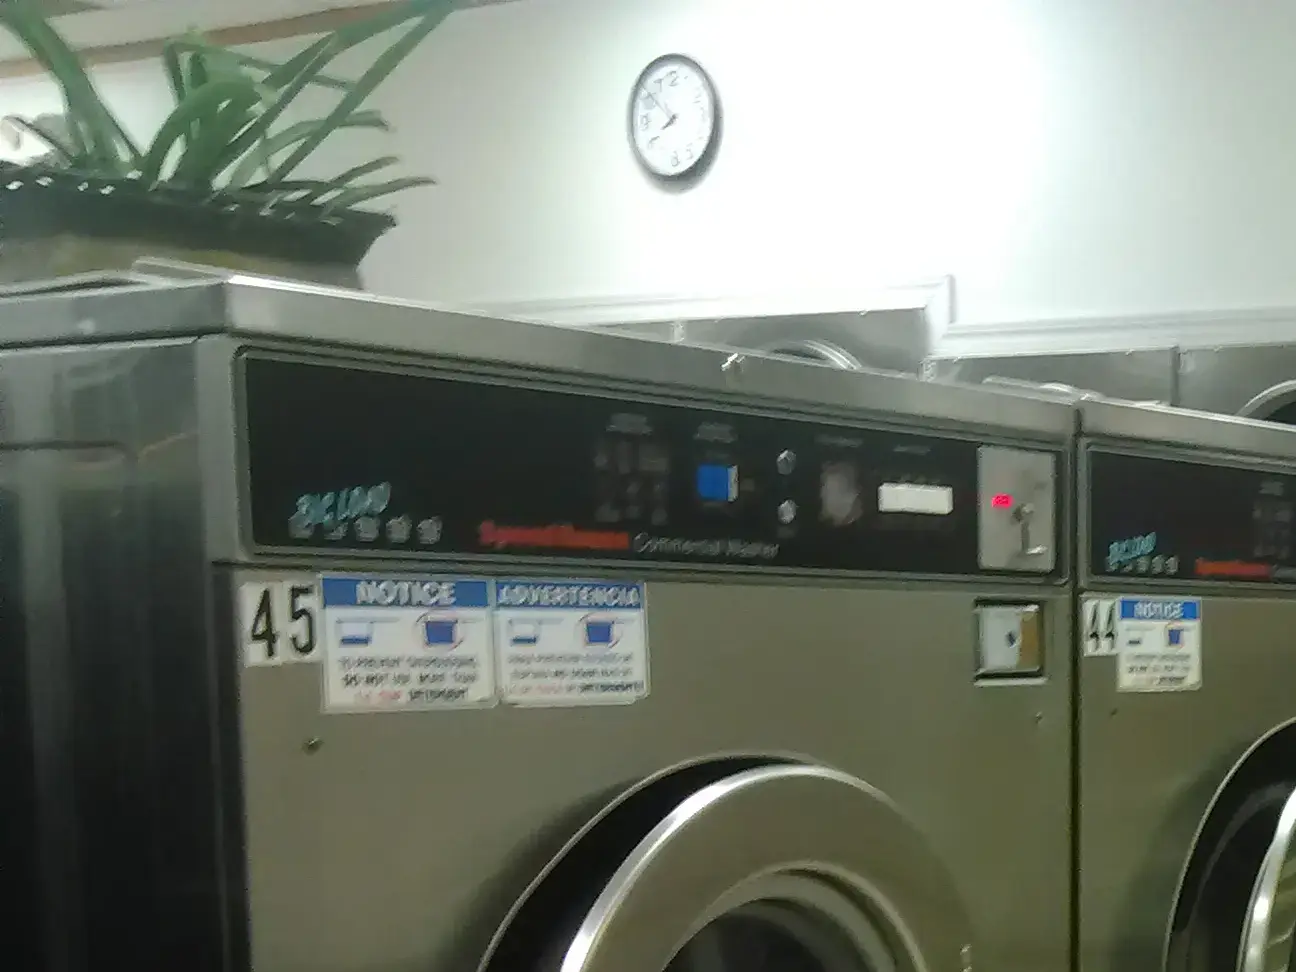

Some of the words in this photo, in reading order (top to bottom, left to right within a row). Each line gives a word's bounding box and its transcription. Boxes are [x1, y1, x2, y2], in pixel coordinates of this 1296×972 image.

[356, 580, 457, 606] NOTICE
[251, 585, 316, 657] 45
[1088, 598, 1117, 652] 44
